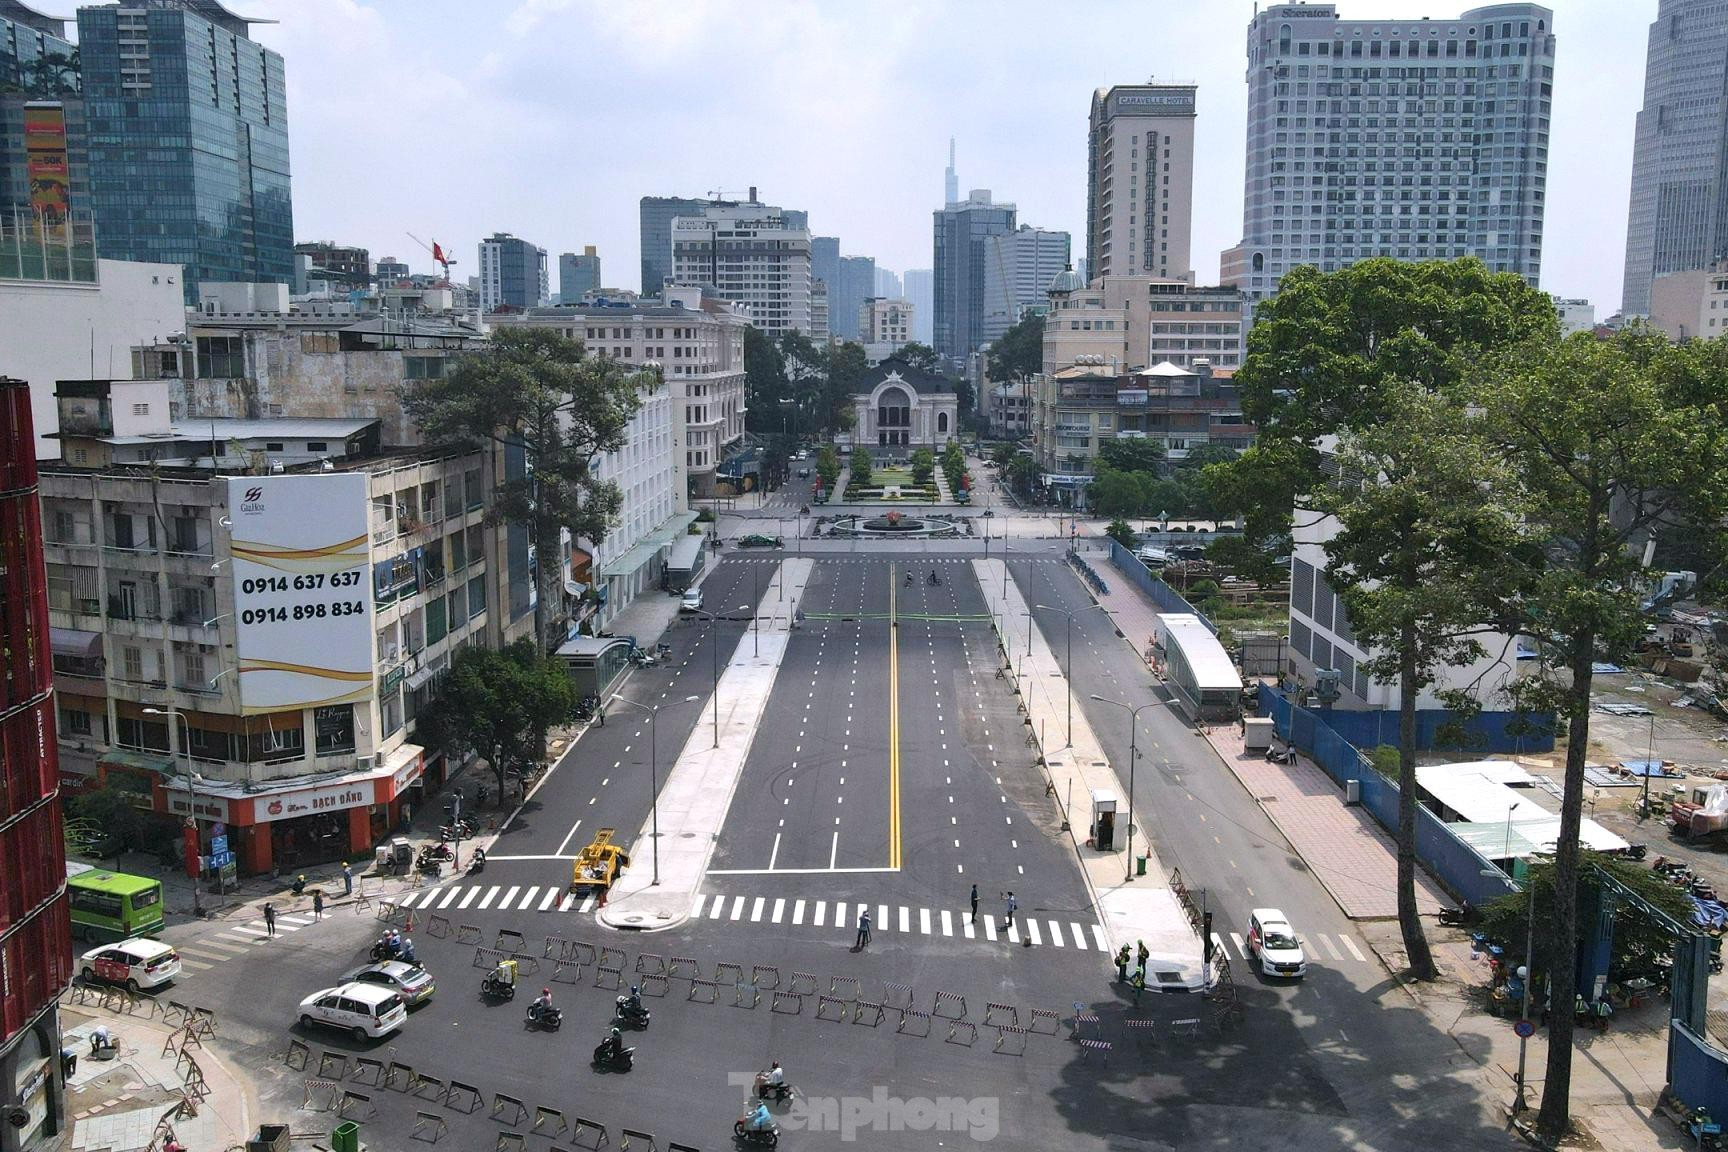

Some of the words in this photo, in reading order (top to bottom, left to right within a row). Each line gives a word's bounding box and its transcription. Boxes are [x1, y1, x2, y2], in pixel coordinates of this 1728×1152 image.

[1281, 8, 1330, 18] Sheraton
[1121, 96, 1164, 104] CARAVELLE
[1167, 96, 1191, 104] HOTEL
[242, 576, 288, 594] 0914
[293, 573, 325, 590] 637
[330, 571, 361, 587] 637
[242, 606, 288, 625] 0914
[292, 603, 327, 620] 898
[331, 600, 364, 616] 834
